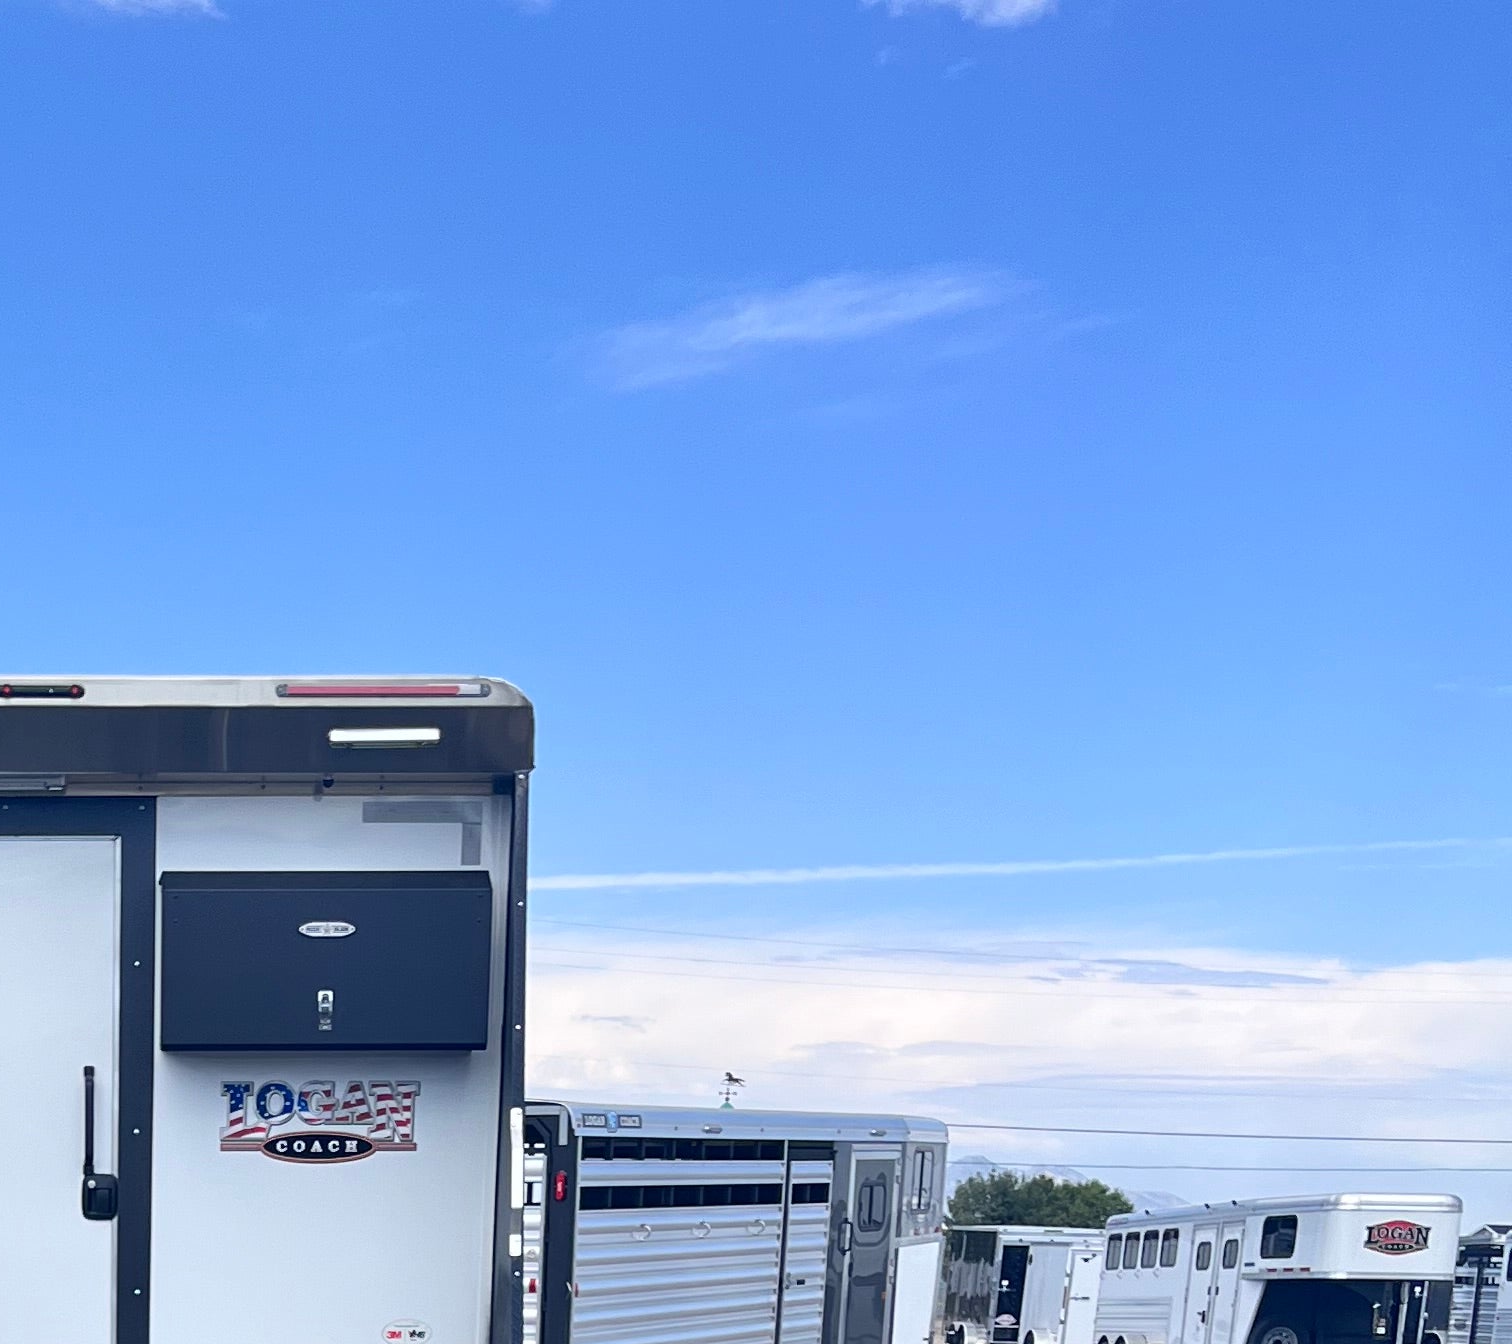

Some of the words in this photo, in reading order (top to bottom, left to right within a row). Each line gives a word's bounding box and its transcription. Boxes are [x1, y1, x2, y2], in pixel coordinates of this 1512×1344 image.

[219, 1080, 421, 1142] LOGAN
[275, 1140, 358, 1153] COACH
[1364, 1226, 1432, 1246] LOGAN
[386, 1330, 402, 1339] 3M
